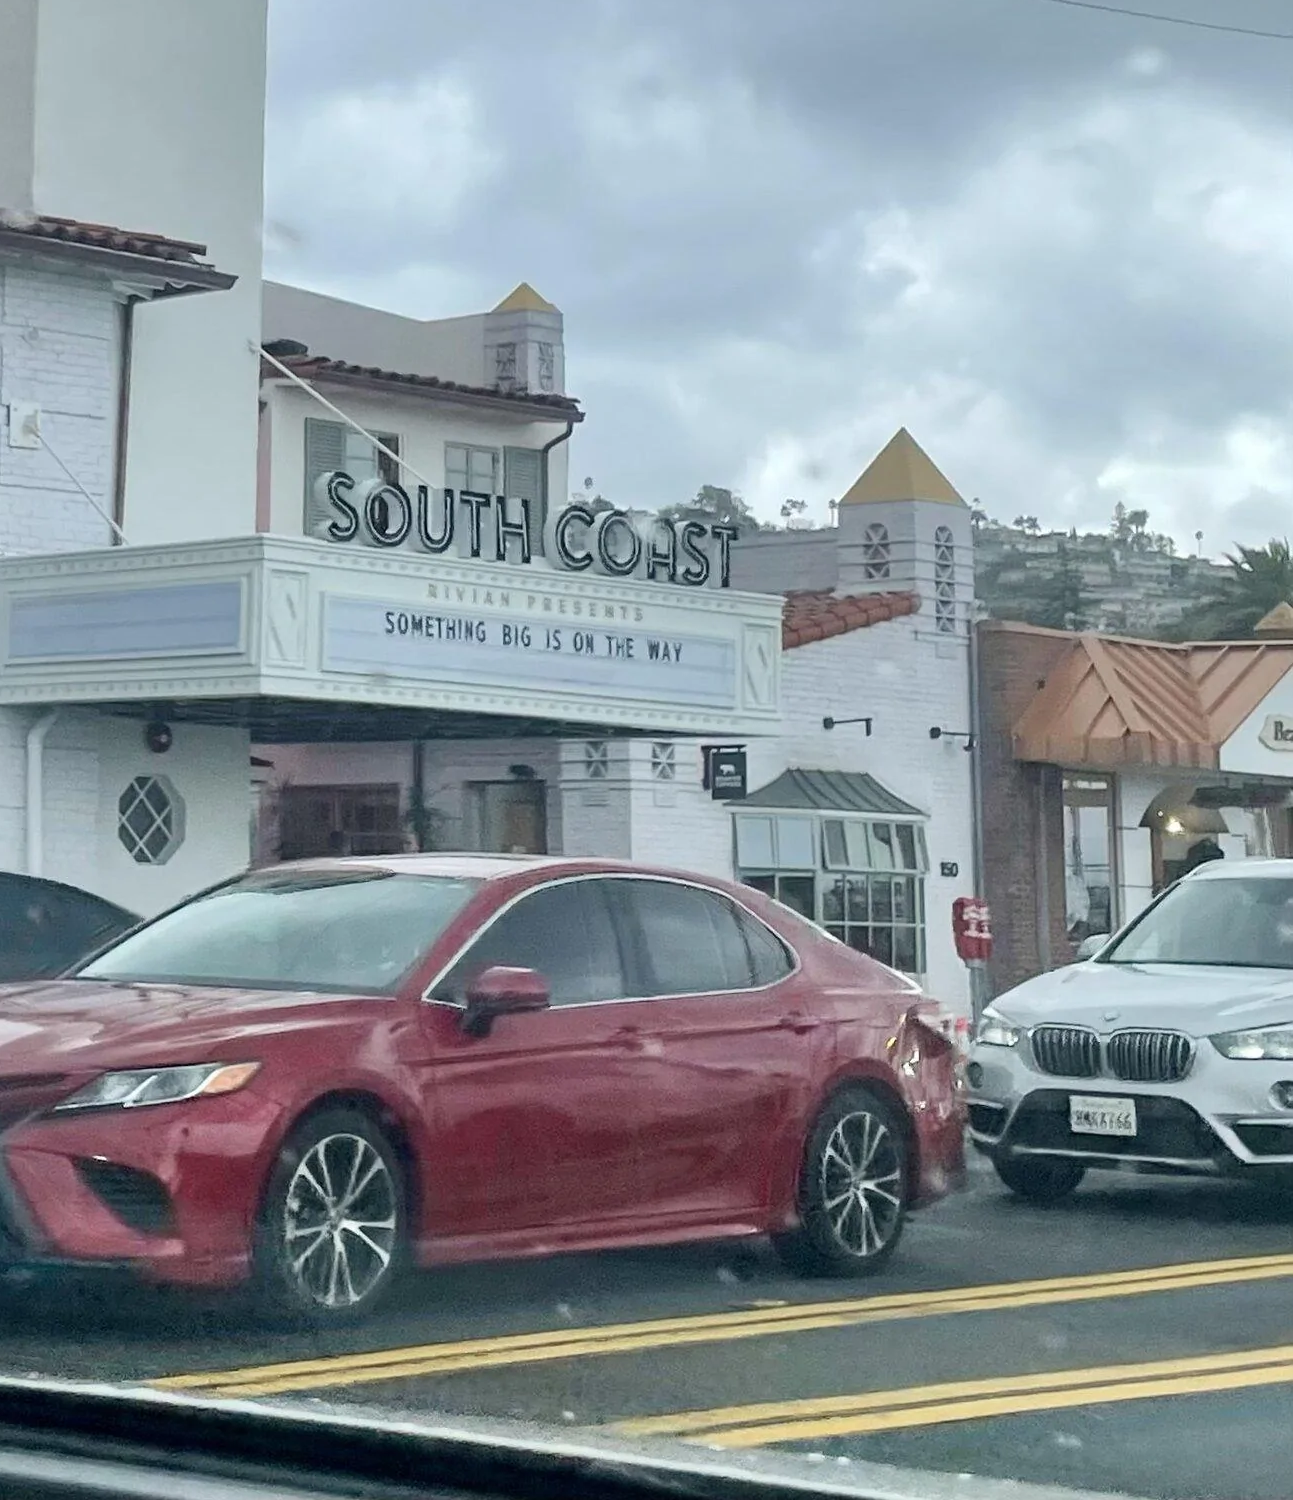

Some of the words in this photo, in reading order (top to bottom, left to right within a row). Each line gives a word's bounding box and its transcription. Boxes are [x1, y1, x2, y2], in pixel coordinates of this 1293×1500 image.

[326, 471, 533, 564] SOUTH
[555, 504, 740, 588] COAST
[426, 583, 510, 606] RIVIAN
[526, 595, 645, 622] PRESENTS
[384, 611, 487, 644] SOMETHING
[501, 624, 532, 648] BIG
[546, 628, 562, 651] IS
[572, 631, 595, 655] ON
[607, 635, 634, 658] THE
[647, 636, 683, 663] WAY
